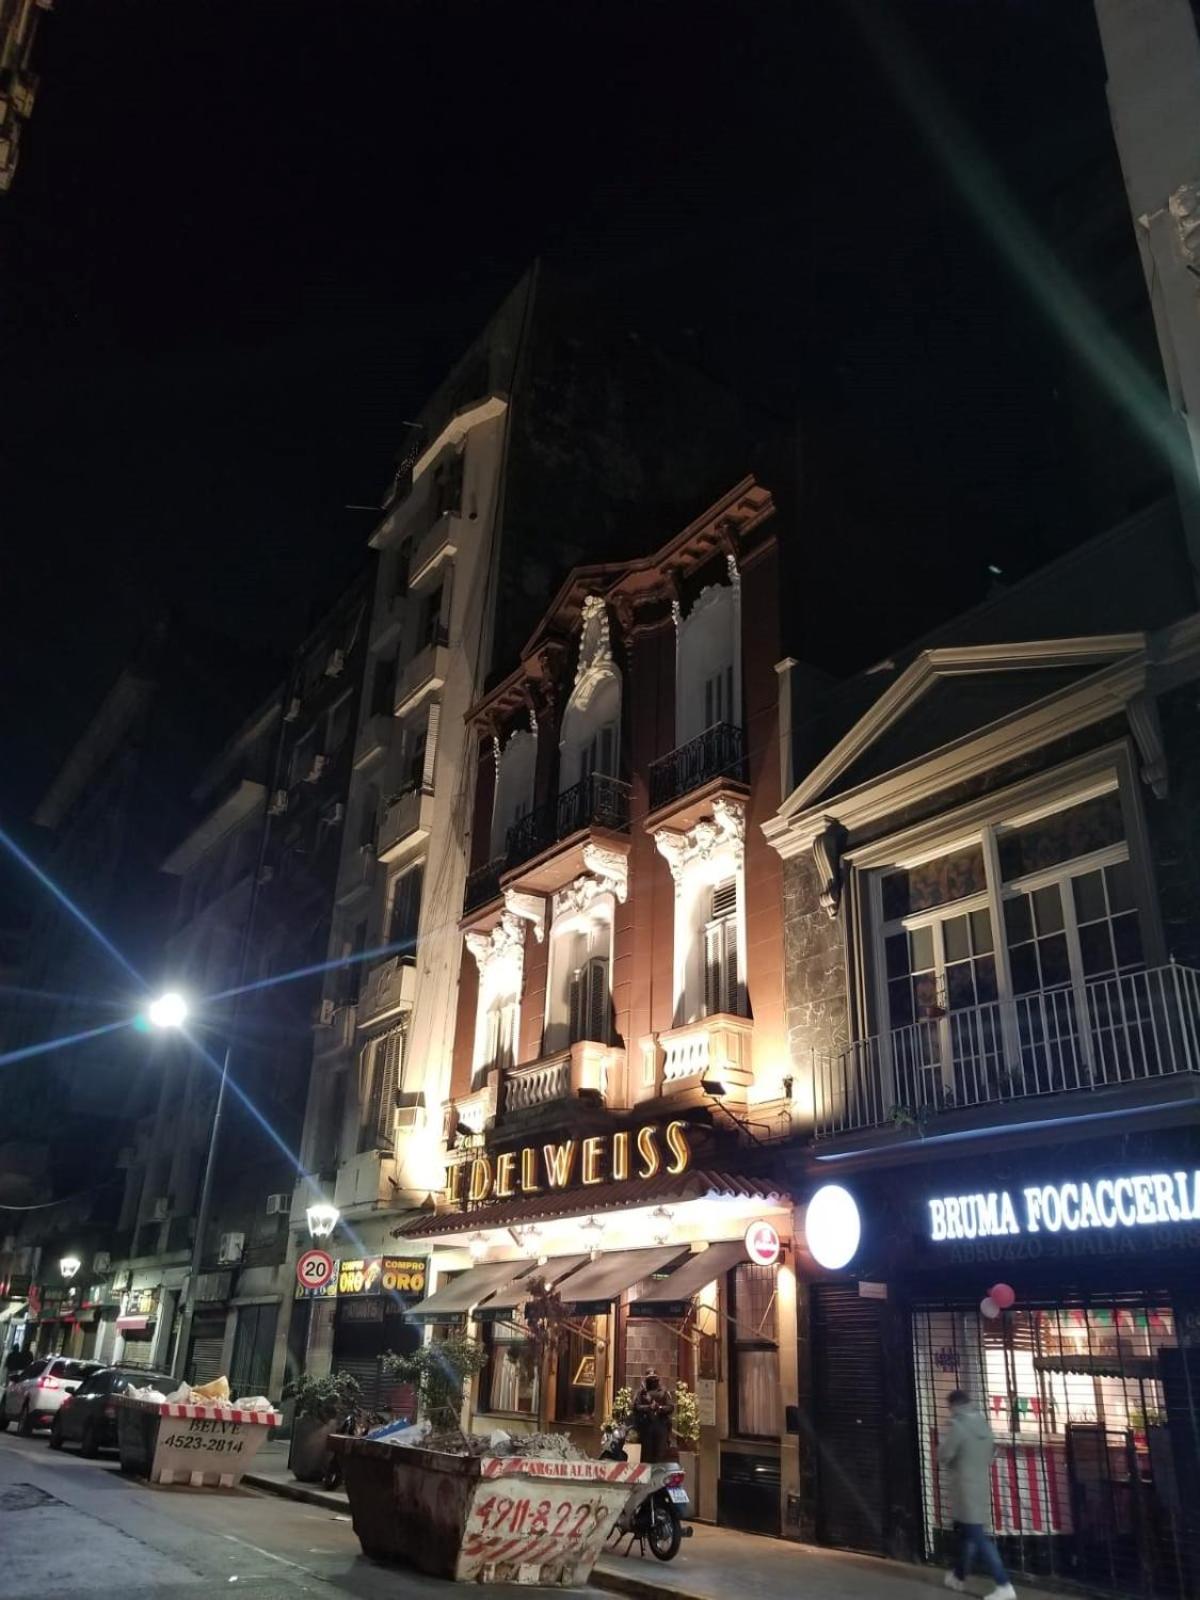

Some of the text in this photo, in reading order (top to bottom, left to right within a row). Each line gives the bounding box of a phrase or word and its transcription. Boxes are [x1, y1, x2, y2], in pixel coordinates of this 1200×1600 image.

[447, 1120, 691, 1204] EDELWEISS
[929, 1192, 1020, 1241] BRUMA
[1058, 1231, 1136, 1257] ITALIA
[305, 1261, 326, 1277] 20
[384, 1260, 425, 1271] COMPRO
[339, 1271, 363, 1293] ORO
[382, 1272, 425, 1292] ORO
[165, 1434, 244, 1453] 4523-2814
[522, 1461, 568, 1477] CARGAR
[570, 1463, 584, 1477] AL
